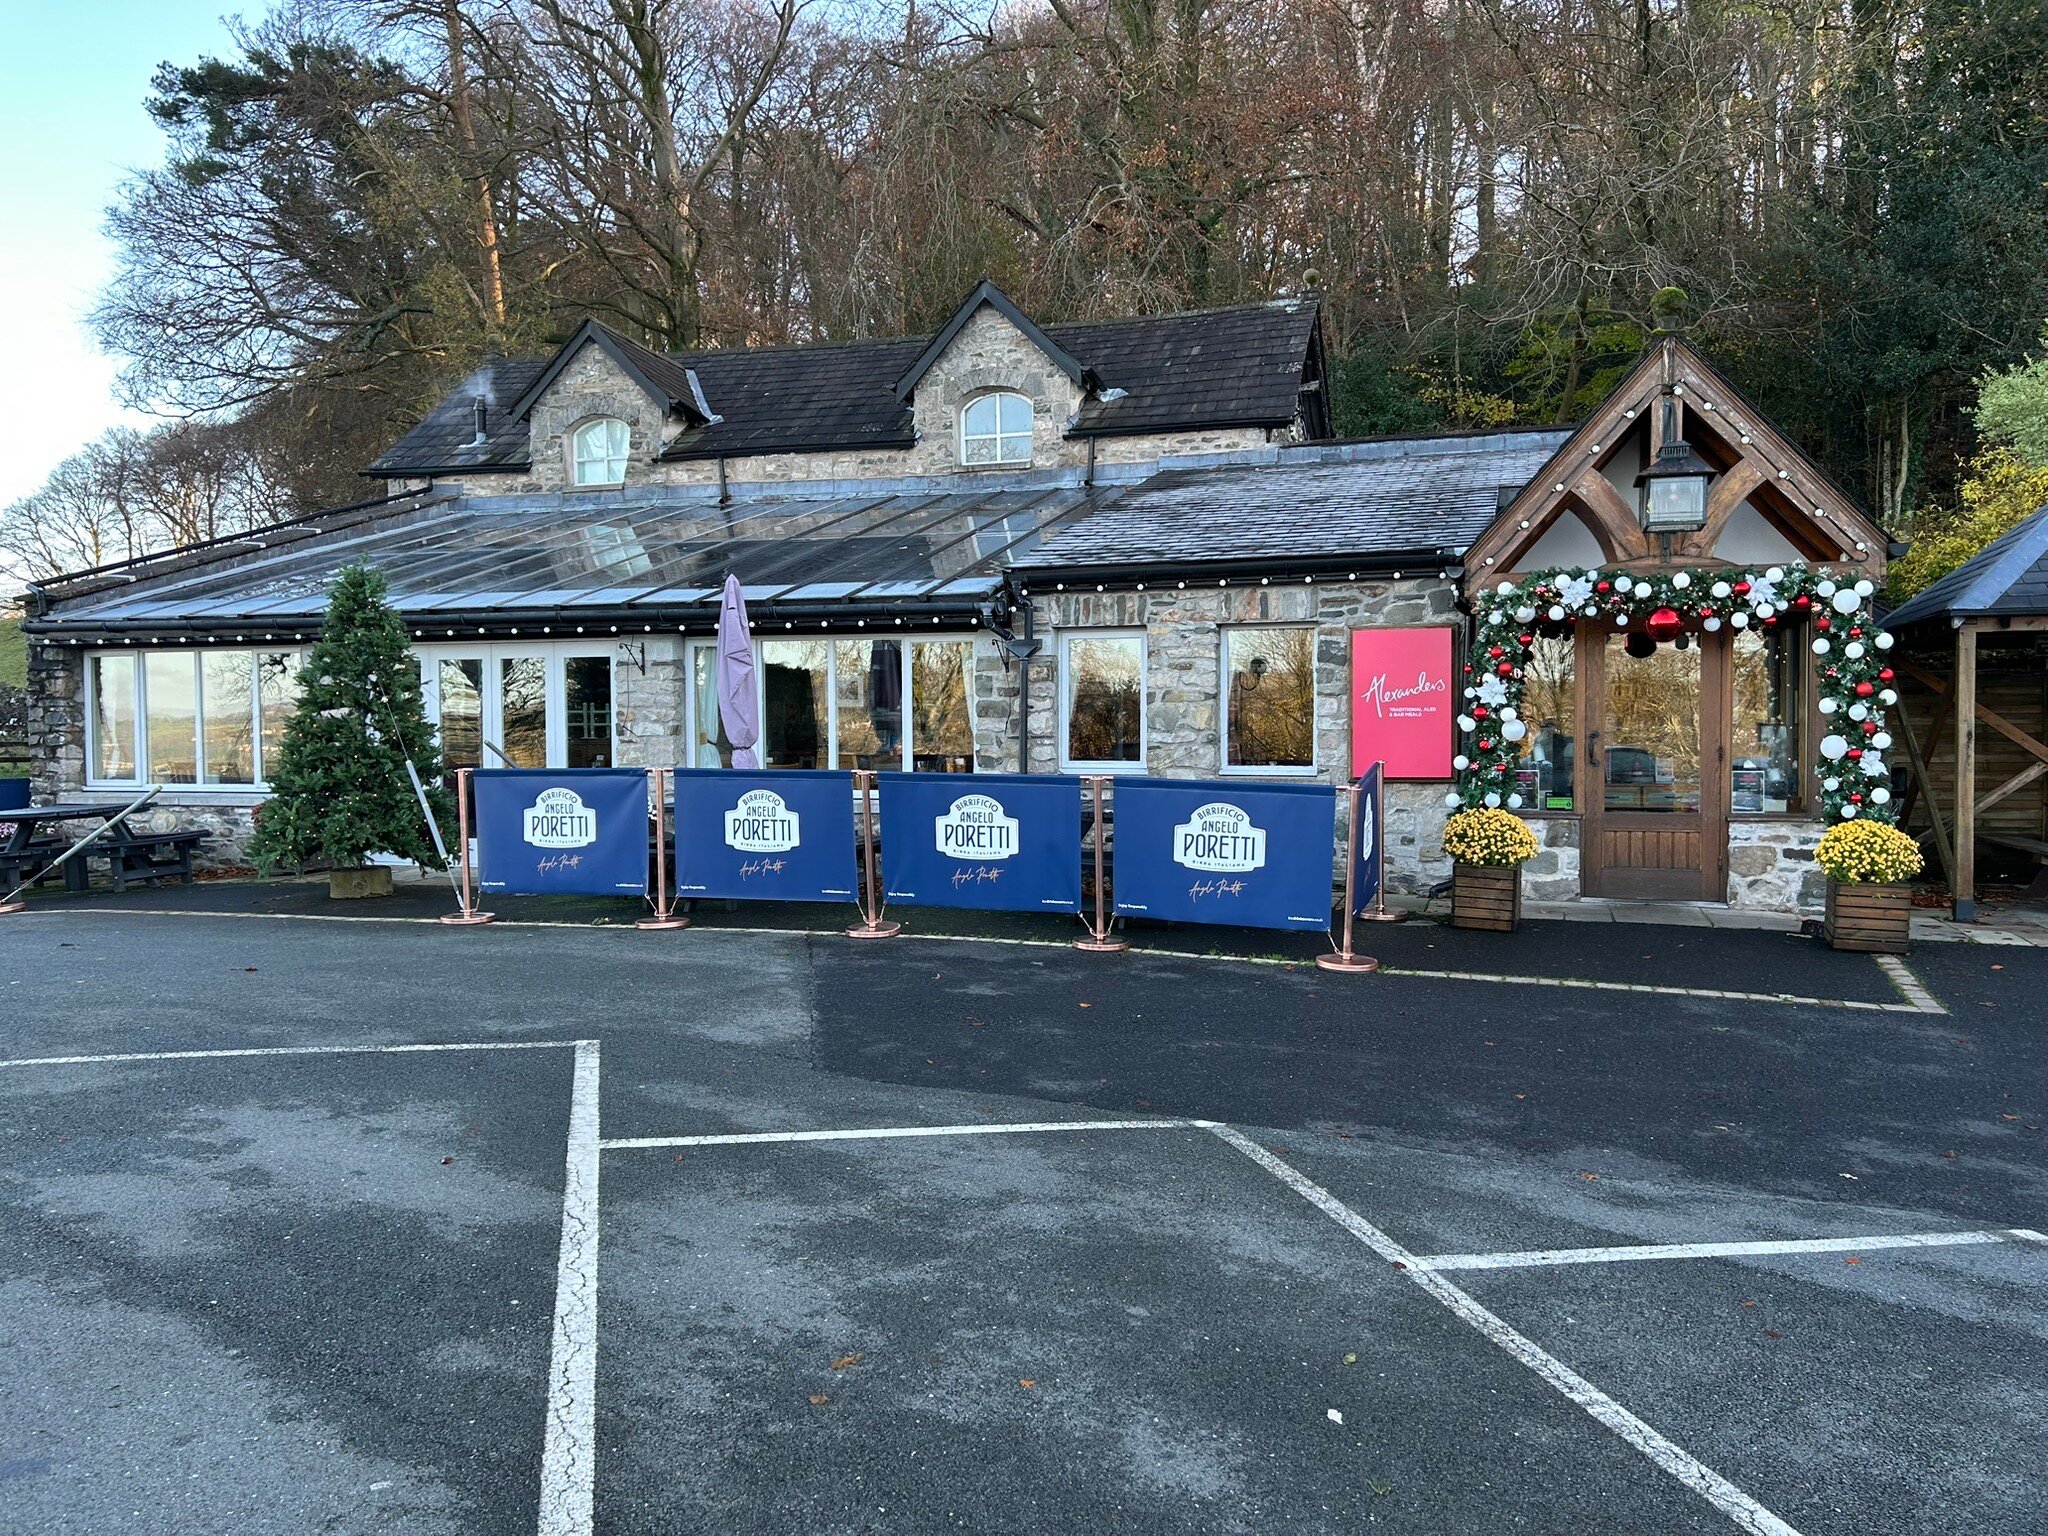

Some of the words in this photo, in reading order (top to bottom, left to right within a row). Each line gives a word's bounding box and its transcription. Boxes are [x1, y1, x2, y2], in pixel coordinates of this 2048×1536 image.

[1361, 671, 1446, 718] Alexanders
[540, 791, 578, 804] BIRRIFICIO
[742, 793, 781, 806] BIRRIFICIO
[545, 803, 574, 815] ANGELO
[746, 805, 777, 818] ANGELO
[955, 798, 999, 812] BIRRIFICIO
[960, 811, 994, 824] ANGELO
[1196, 806, 1244, 822] BIRRIFICIO
[532, 815, 588, 837] PORETTI
[733, 818, 791, 841] PORETTI
[1201, 820, 1238, 834] ANGELO
[945, 824, 1009, 849] PORETTI
[1184, 833, 1255, 861] PORETTI
